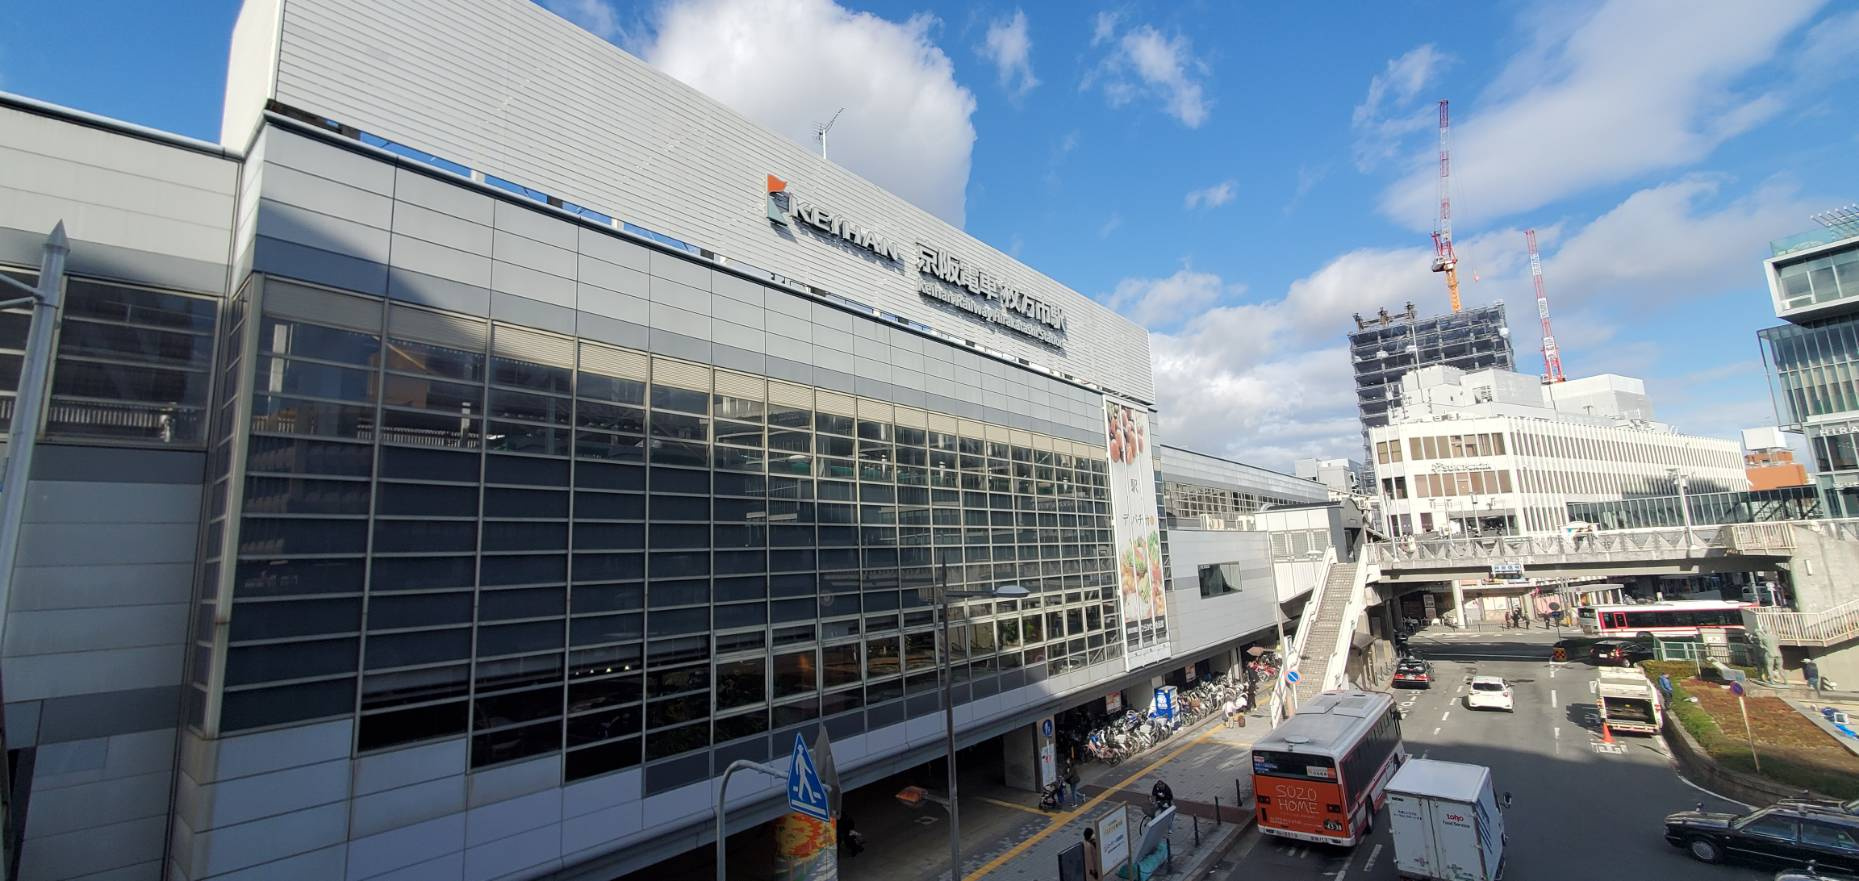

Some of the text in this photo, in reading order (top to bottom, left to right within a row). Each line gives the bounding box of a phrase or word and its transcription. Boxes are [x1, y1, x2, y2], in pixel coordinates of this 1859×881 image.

[788, 192, 899, 262] KEIHAN
[917, 277, 955, 305] Keihan
[955, 293, 993, 322] Railway
[1277, 798, 1320, 814] HOME
